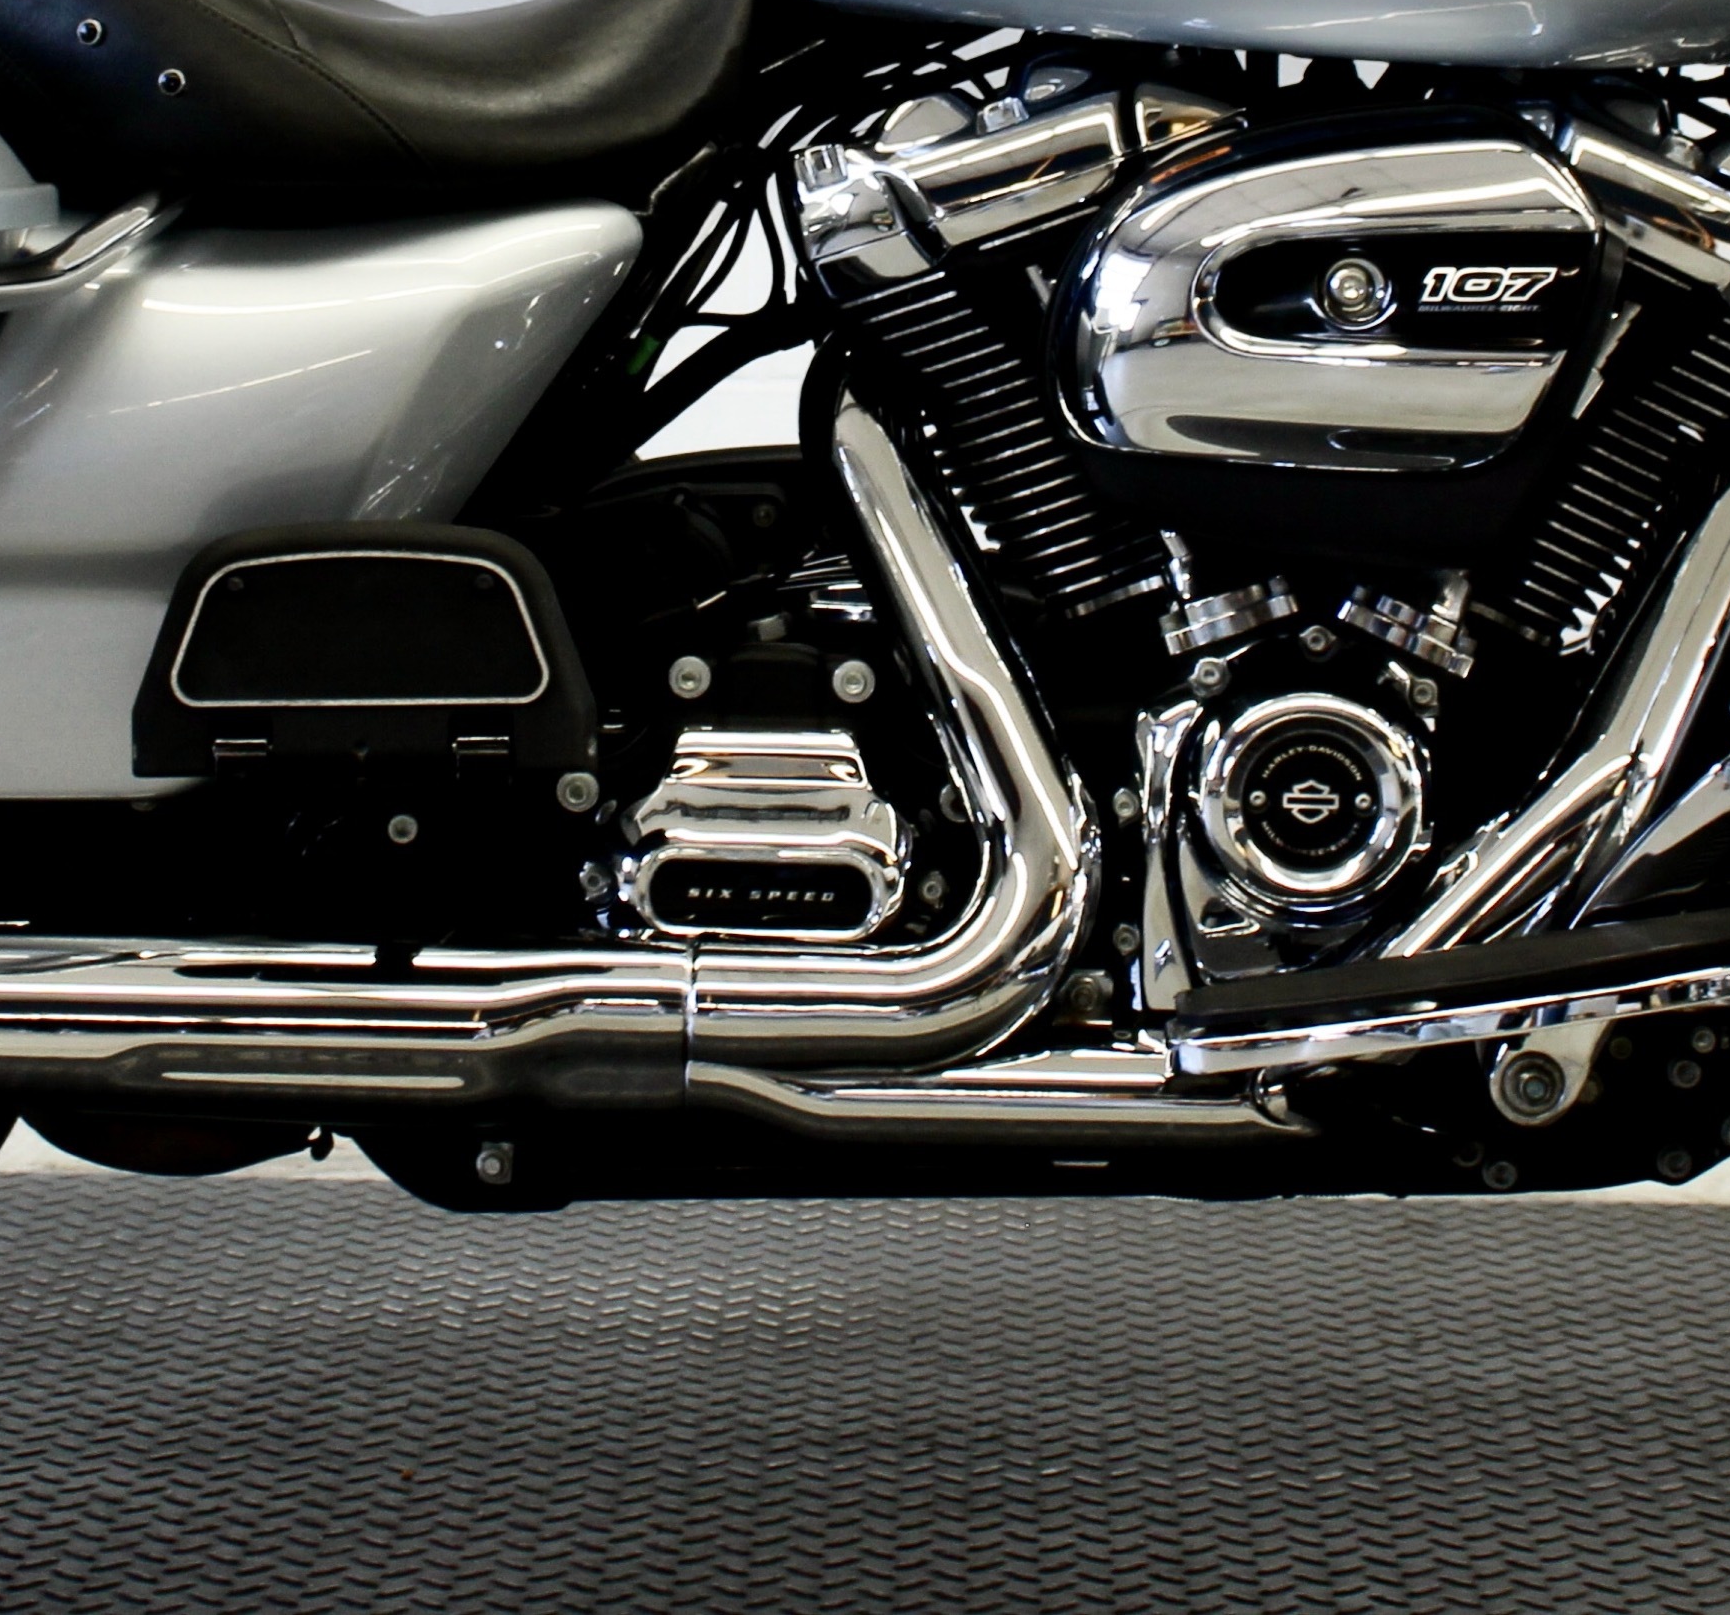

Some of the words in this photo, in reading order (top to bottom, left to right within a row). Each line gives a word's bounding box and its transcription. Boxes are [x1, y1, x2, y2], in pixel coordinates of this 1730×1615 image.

[1420, 266, 1559, 303] 107
[1262, 746, 1362, 781] HARLEY-DAVIDSON
[688, 888, 733, 899] SIX
[750, 890, 835, 902] SPEED
